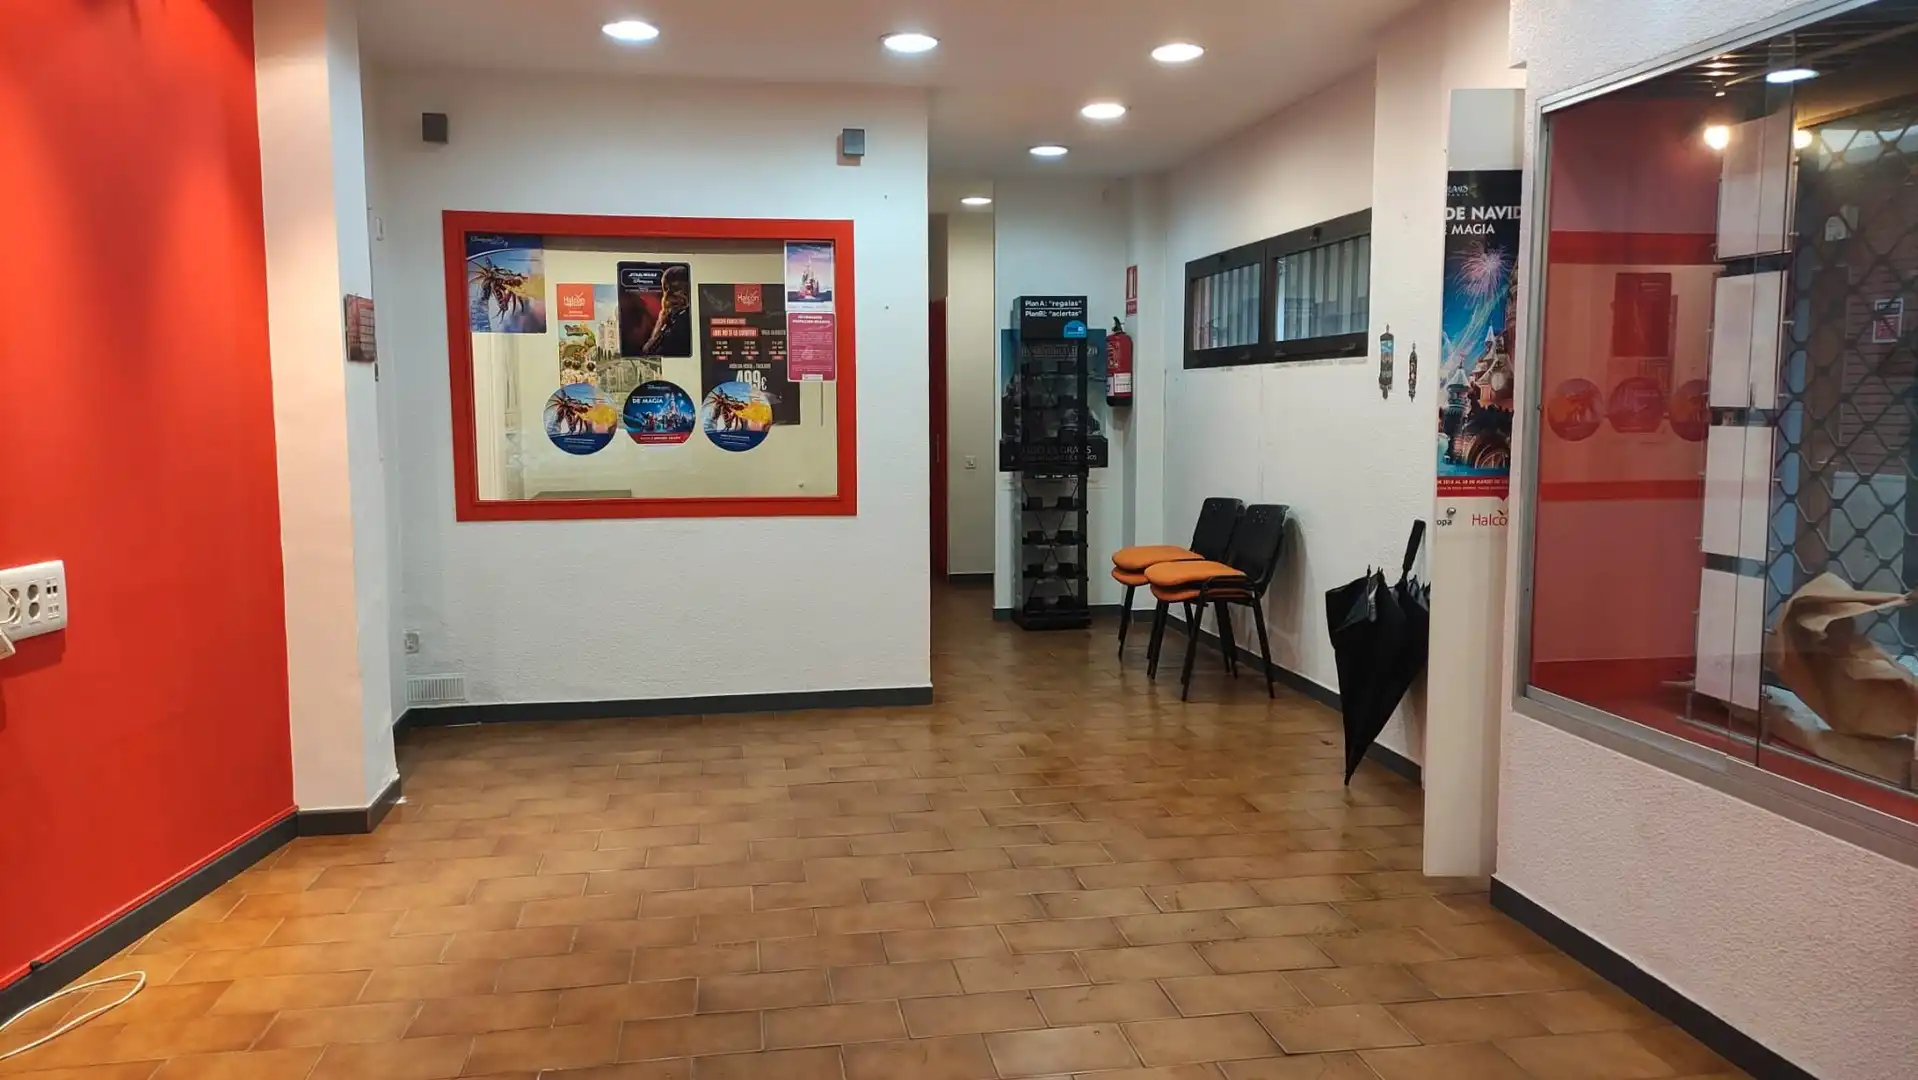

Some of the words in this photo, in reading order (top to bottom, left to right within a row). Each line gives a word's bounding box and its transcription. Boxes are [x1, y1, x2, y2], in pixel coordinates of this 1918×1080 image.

[1445, 206, 1466, 221] DE
[1471, 205, 1522, 220] NAVID
[1451, 223, 1496, 235] MAGIA
